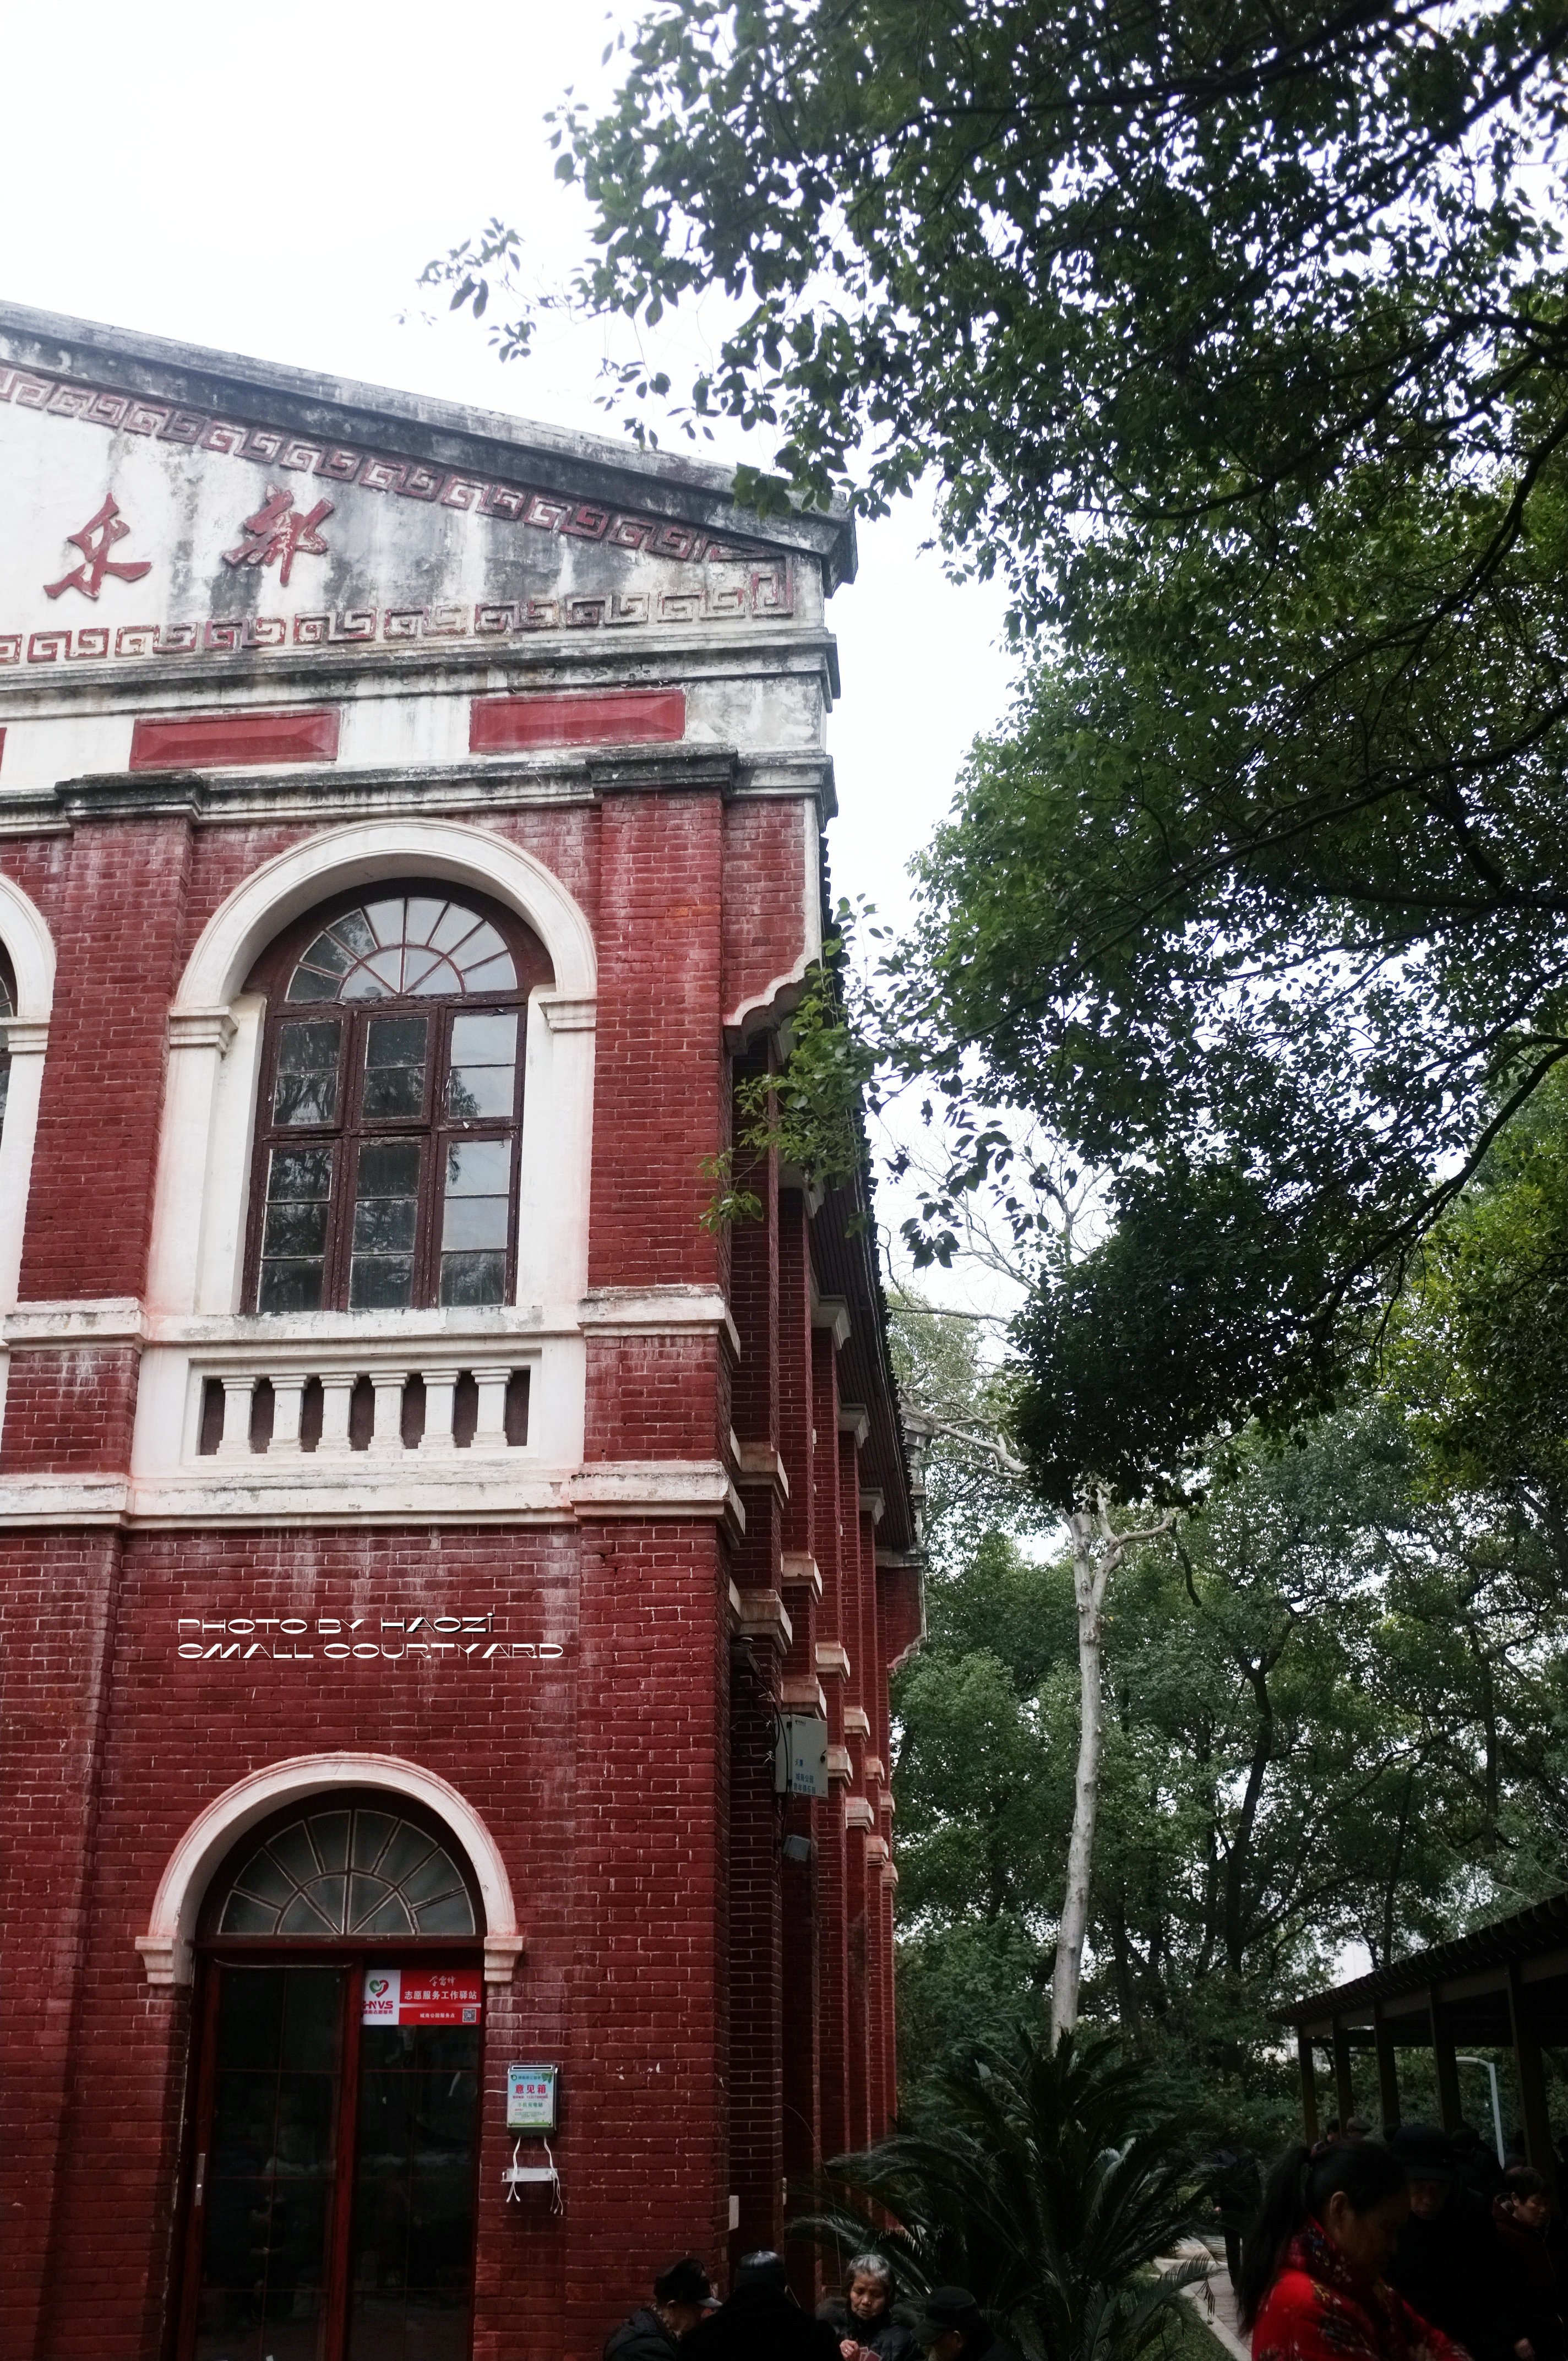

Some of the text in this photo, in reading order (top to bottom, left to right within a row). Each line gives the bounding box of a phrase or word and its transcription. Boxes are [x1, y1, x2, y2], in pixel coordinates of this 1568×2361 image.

[429, 1975, 456, 1987] 学雷锋
[404, 1990, 477, 2000] 志愿服务工作驿站
[515, 2084, 546, 2094] 意见箱
